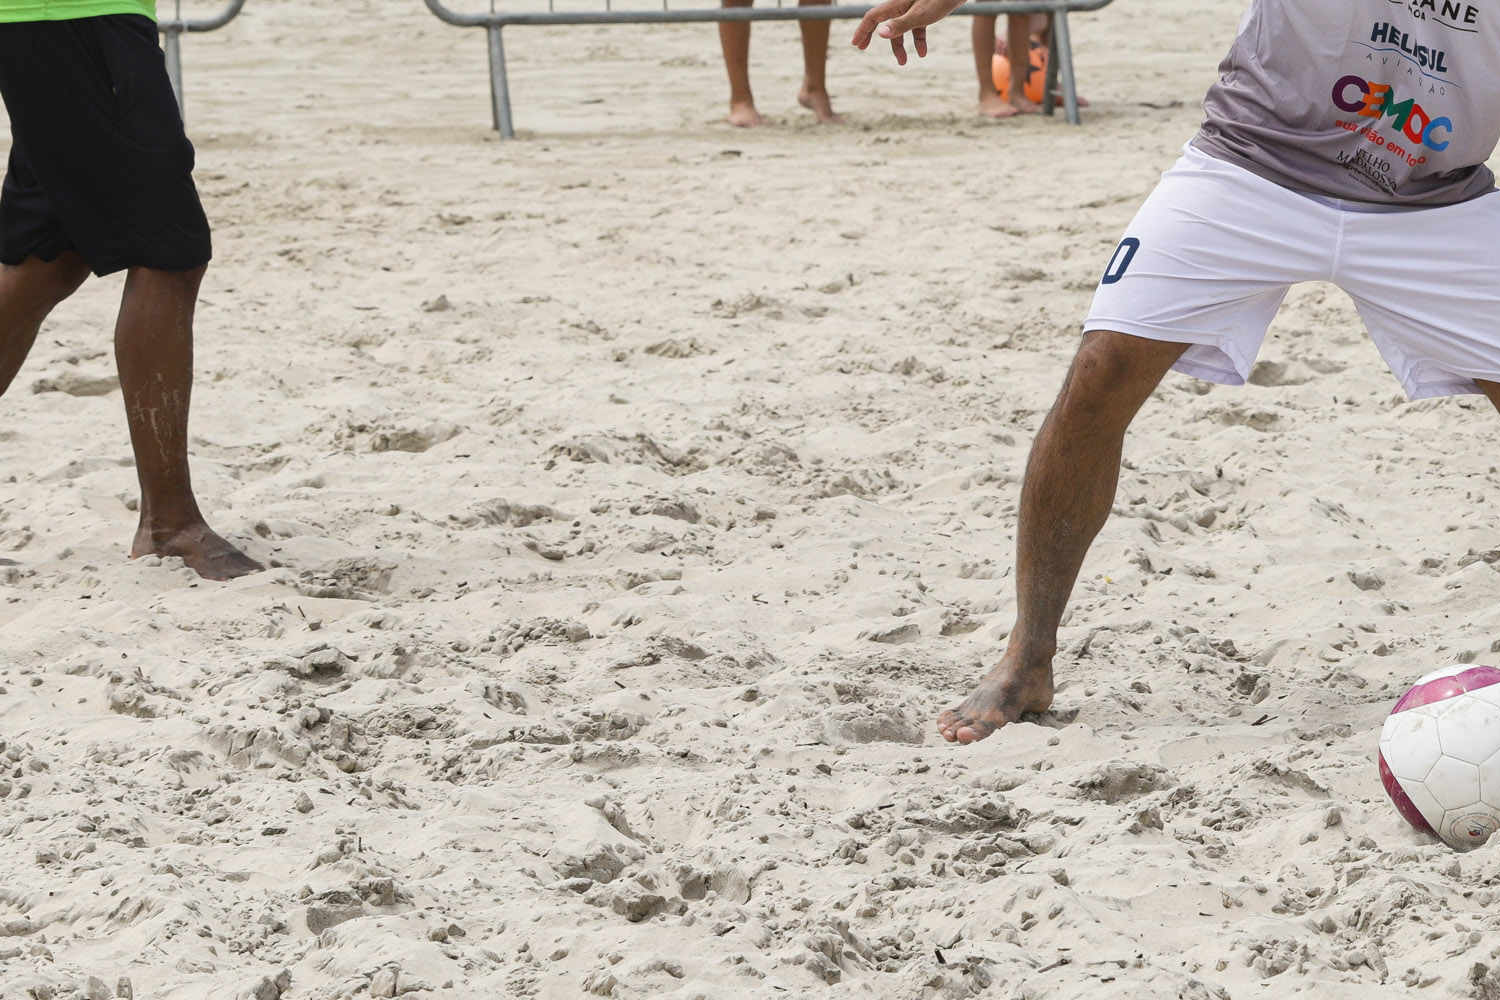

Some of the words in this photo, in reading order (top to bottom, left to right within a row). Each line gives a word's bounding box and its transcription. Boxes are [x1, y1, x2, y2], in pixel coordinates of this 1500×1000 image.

[1370, 22, 1448, 73] HELISUL
[1331, 75, 1453, 152] CEMOC
[1386, 142, 1406, 159] em
